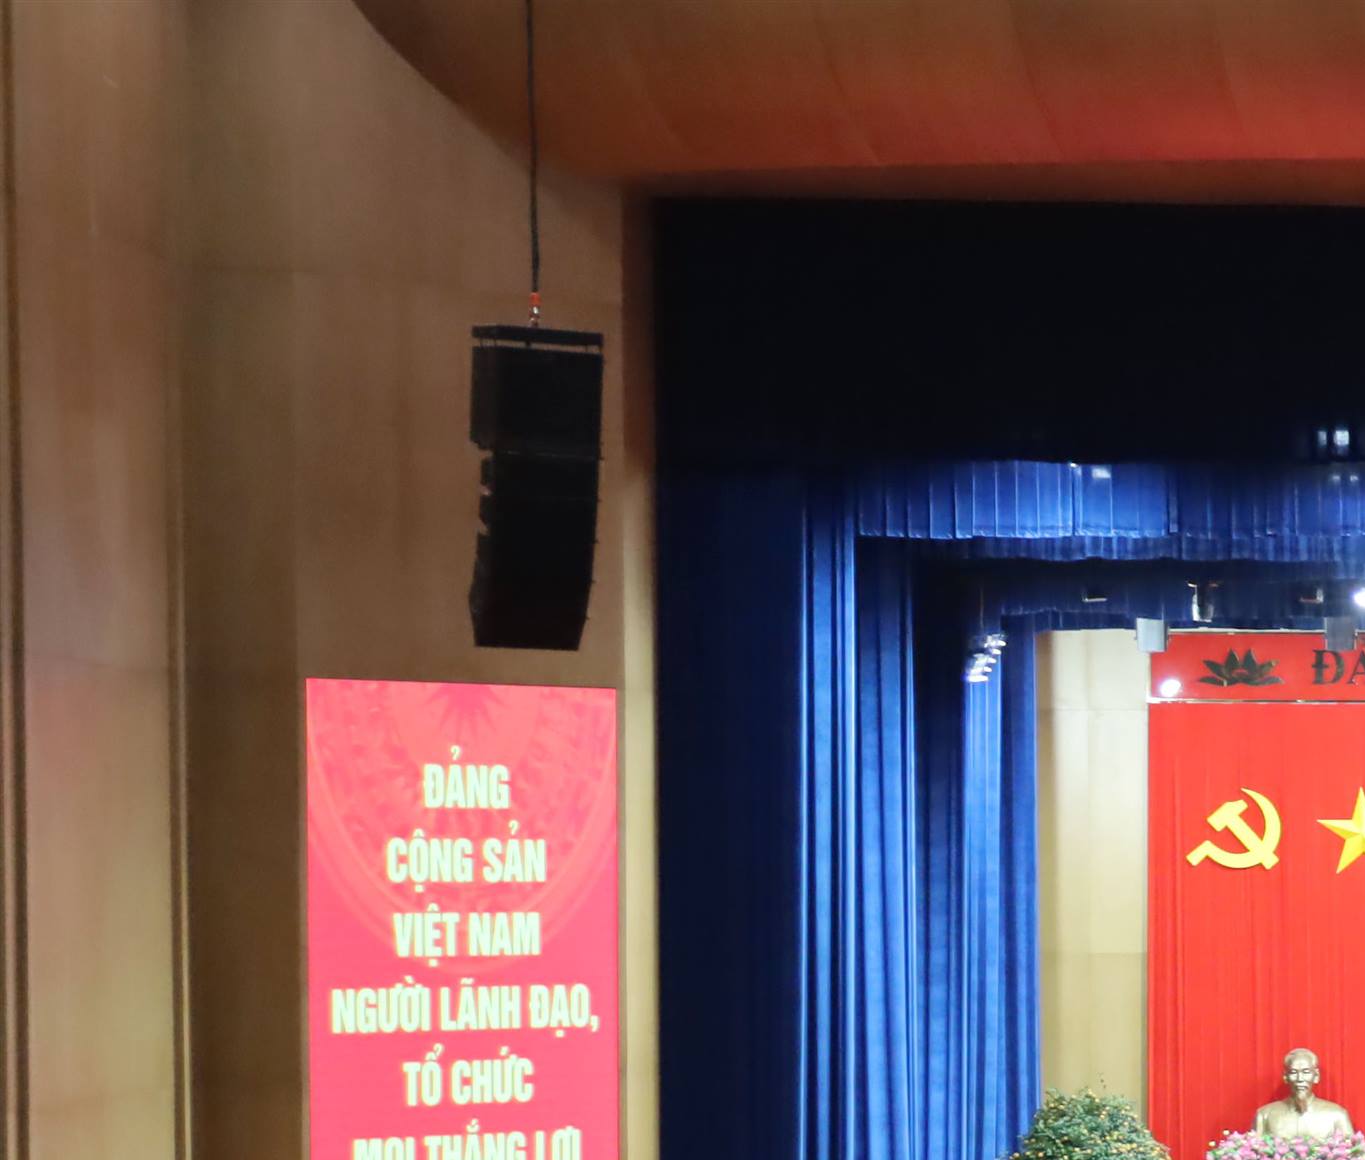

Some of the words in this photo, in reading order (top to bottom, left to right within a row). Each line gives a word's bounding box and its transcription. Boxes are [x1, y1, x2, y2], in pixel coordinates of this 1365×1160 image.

[421, 745, 511, 809] ĐẢNG
[385, 828, 474, 893] CỘNG
[482, 820, 547, 883] SẢN
[392, 903, 461, 968] VIỆT
[466, 911, 541, 956] NAM
[331, 976, 431, 1033] NGƯỜI
[440, 978, 521, 1031] LÃNH
[528, 984, 599, 1037] ĐẠO,
[402, 1043, 443, 1106] TỔ
[451, 1046, 534, 1104] CHỨC
